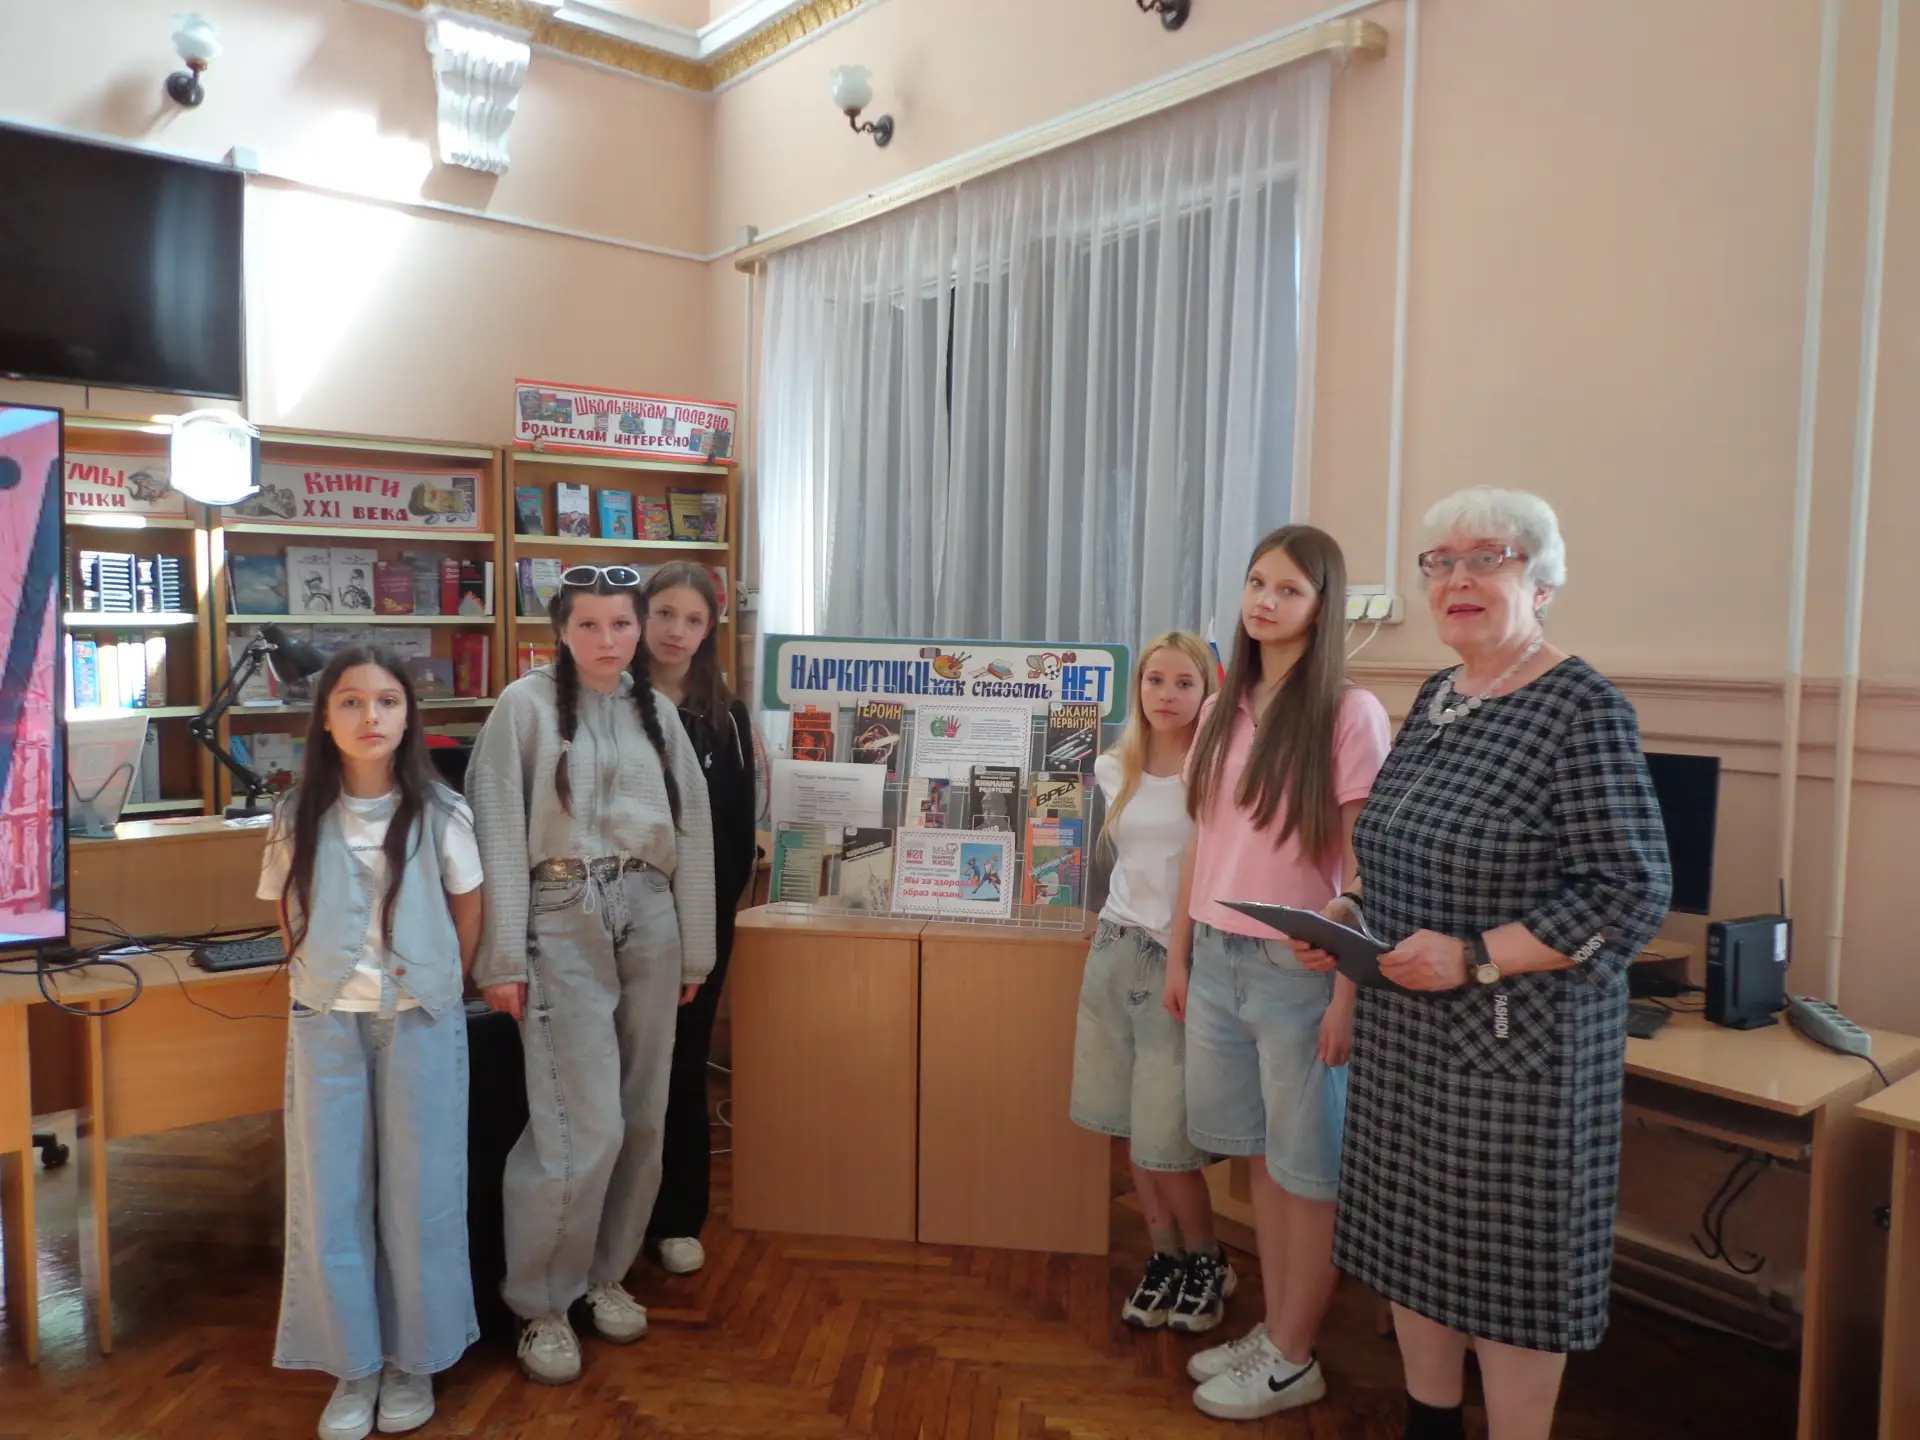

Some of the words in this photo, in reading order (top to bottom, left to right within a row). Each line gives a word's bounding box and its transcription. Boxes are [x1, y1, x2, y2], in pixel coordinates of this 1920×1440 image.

[521, 421, 607, 443] РОДИТЕЛЯМ
[614, 434, 690, 449] ИНТЕРЕСНО
[303, 471, 401, 499] КНИГИ
[302, 499, 341, 518] XXI
[352, 506, 409, 521] ВЕКА
[971, 679, 1052, 700] сказать
[1061, 665, 1112, 702] НЕТ
[857, 703, 902, 720] ГЕРОИН
[1050, 717, 1097, 729] ПЕРВИТИН
[1051, 706, 1097, 717] КОКАИН
[1036, 781, 1077, 807] ВРЕД
[1494, 994, 1508, 1039] FASHION
